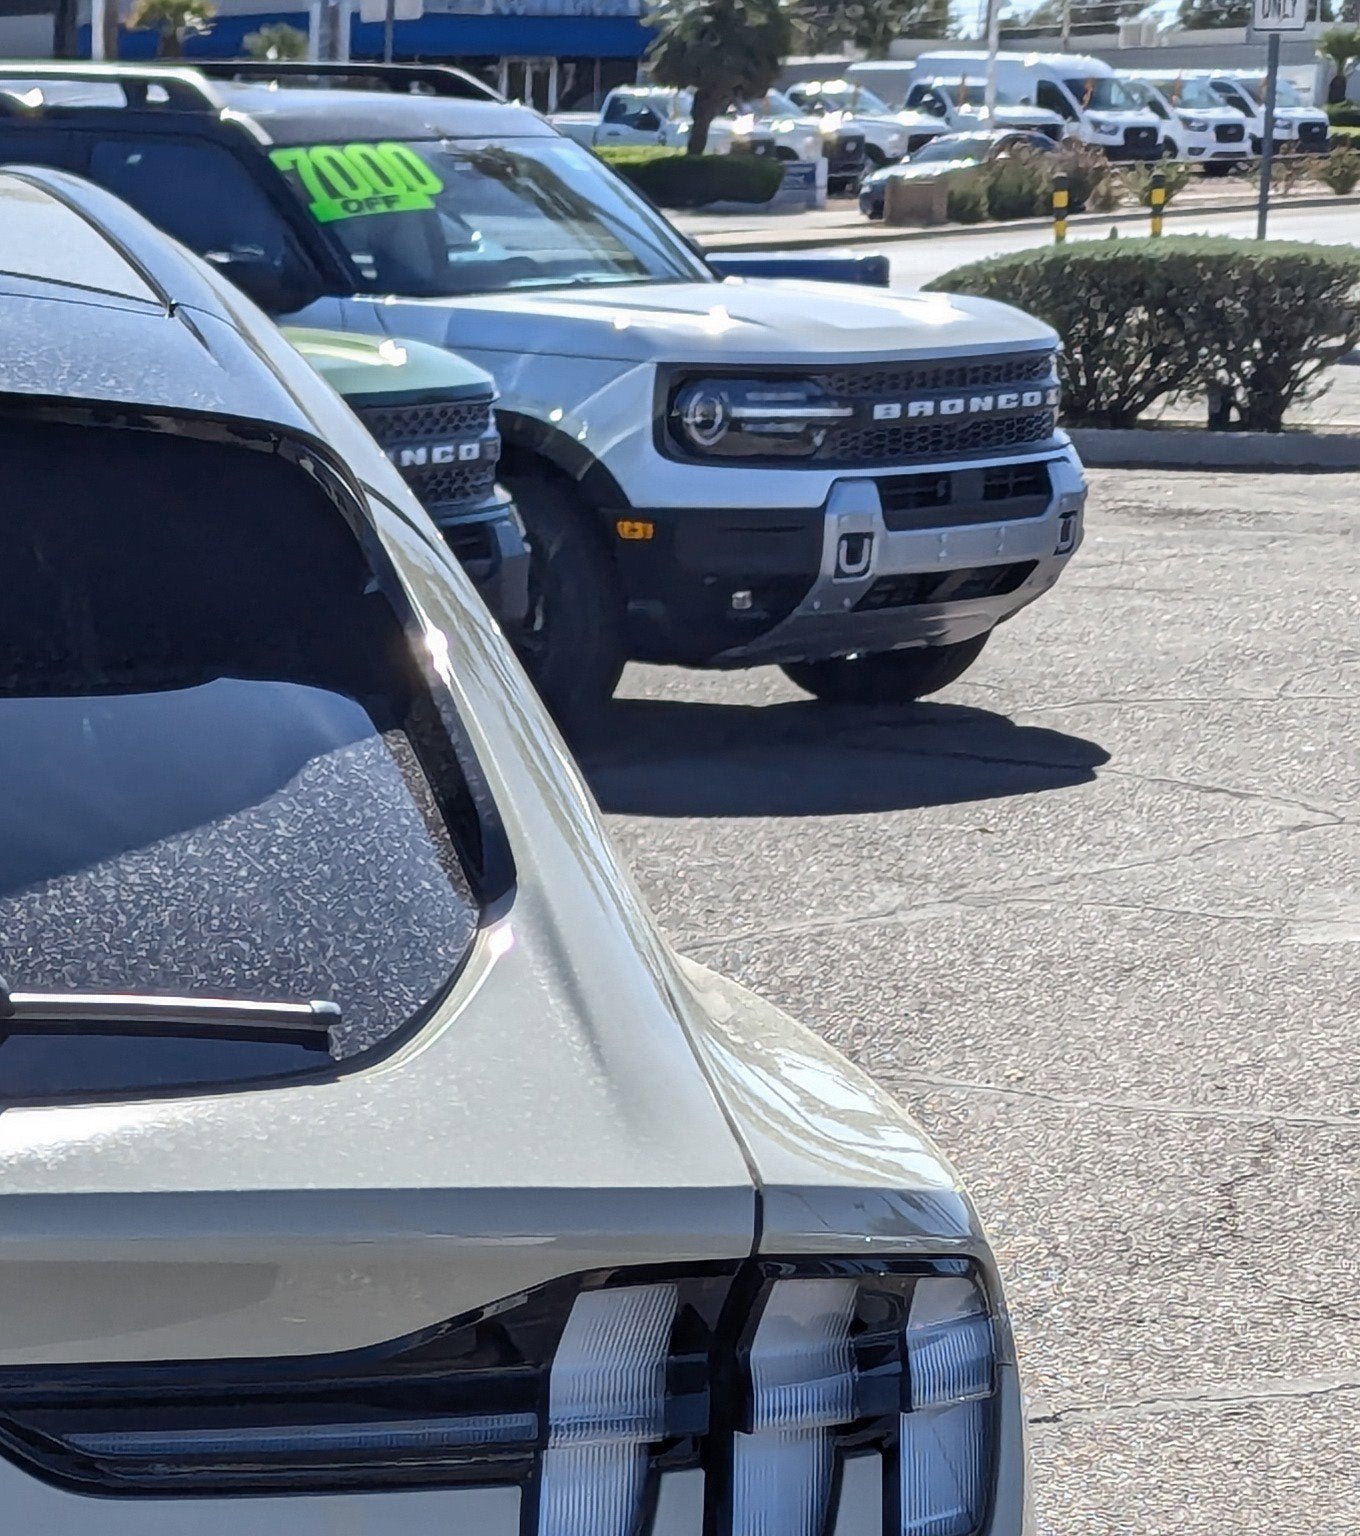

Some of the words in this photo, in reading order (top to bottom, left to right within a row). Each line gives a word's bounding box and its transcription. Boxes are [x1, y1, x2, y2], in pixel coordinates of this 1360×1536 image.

[269, 142, 444, 203] 7000
[341, 195, 402, 214] OFF
[873, 391, 1042, 420] BRONCO
[387, 443, 480, 467] NCO
